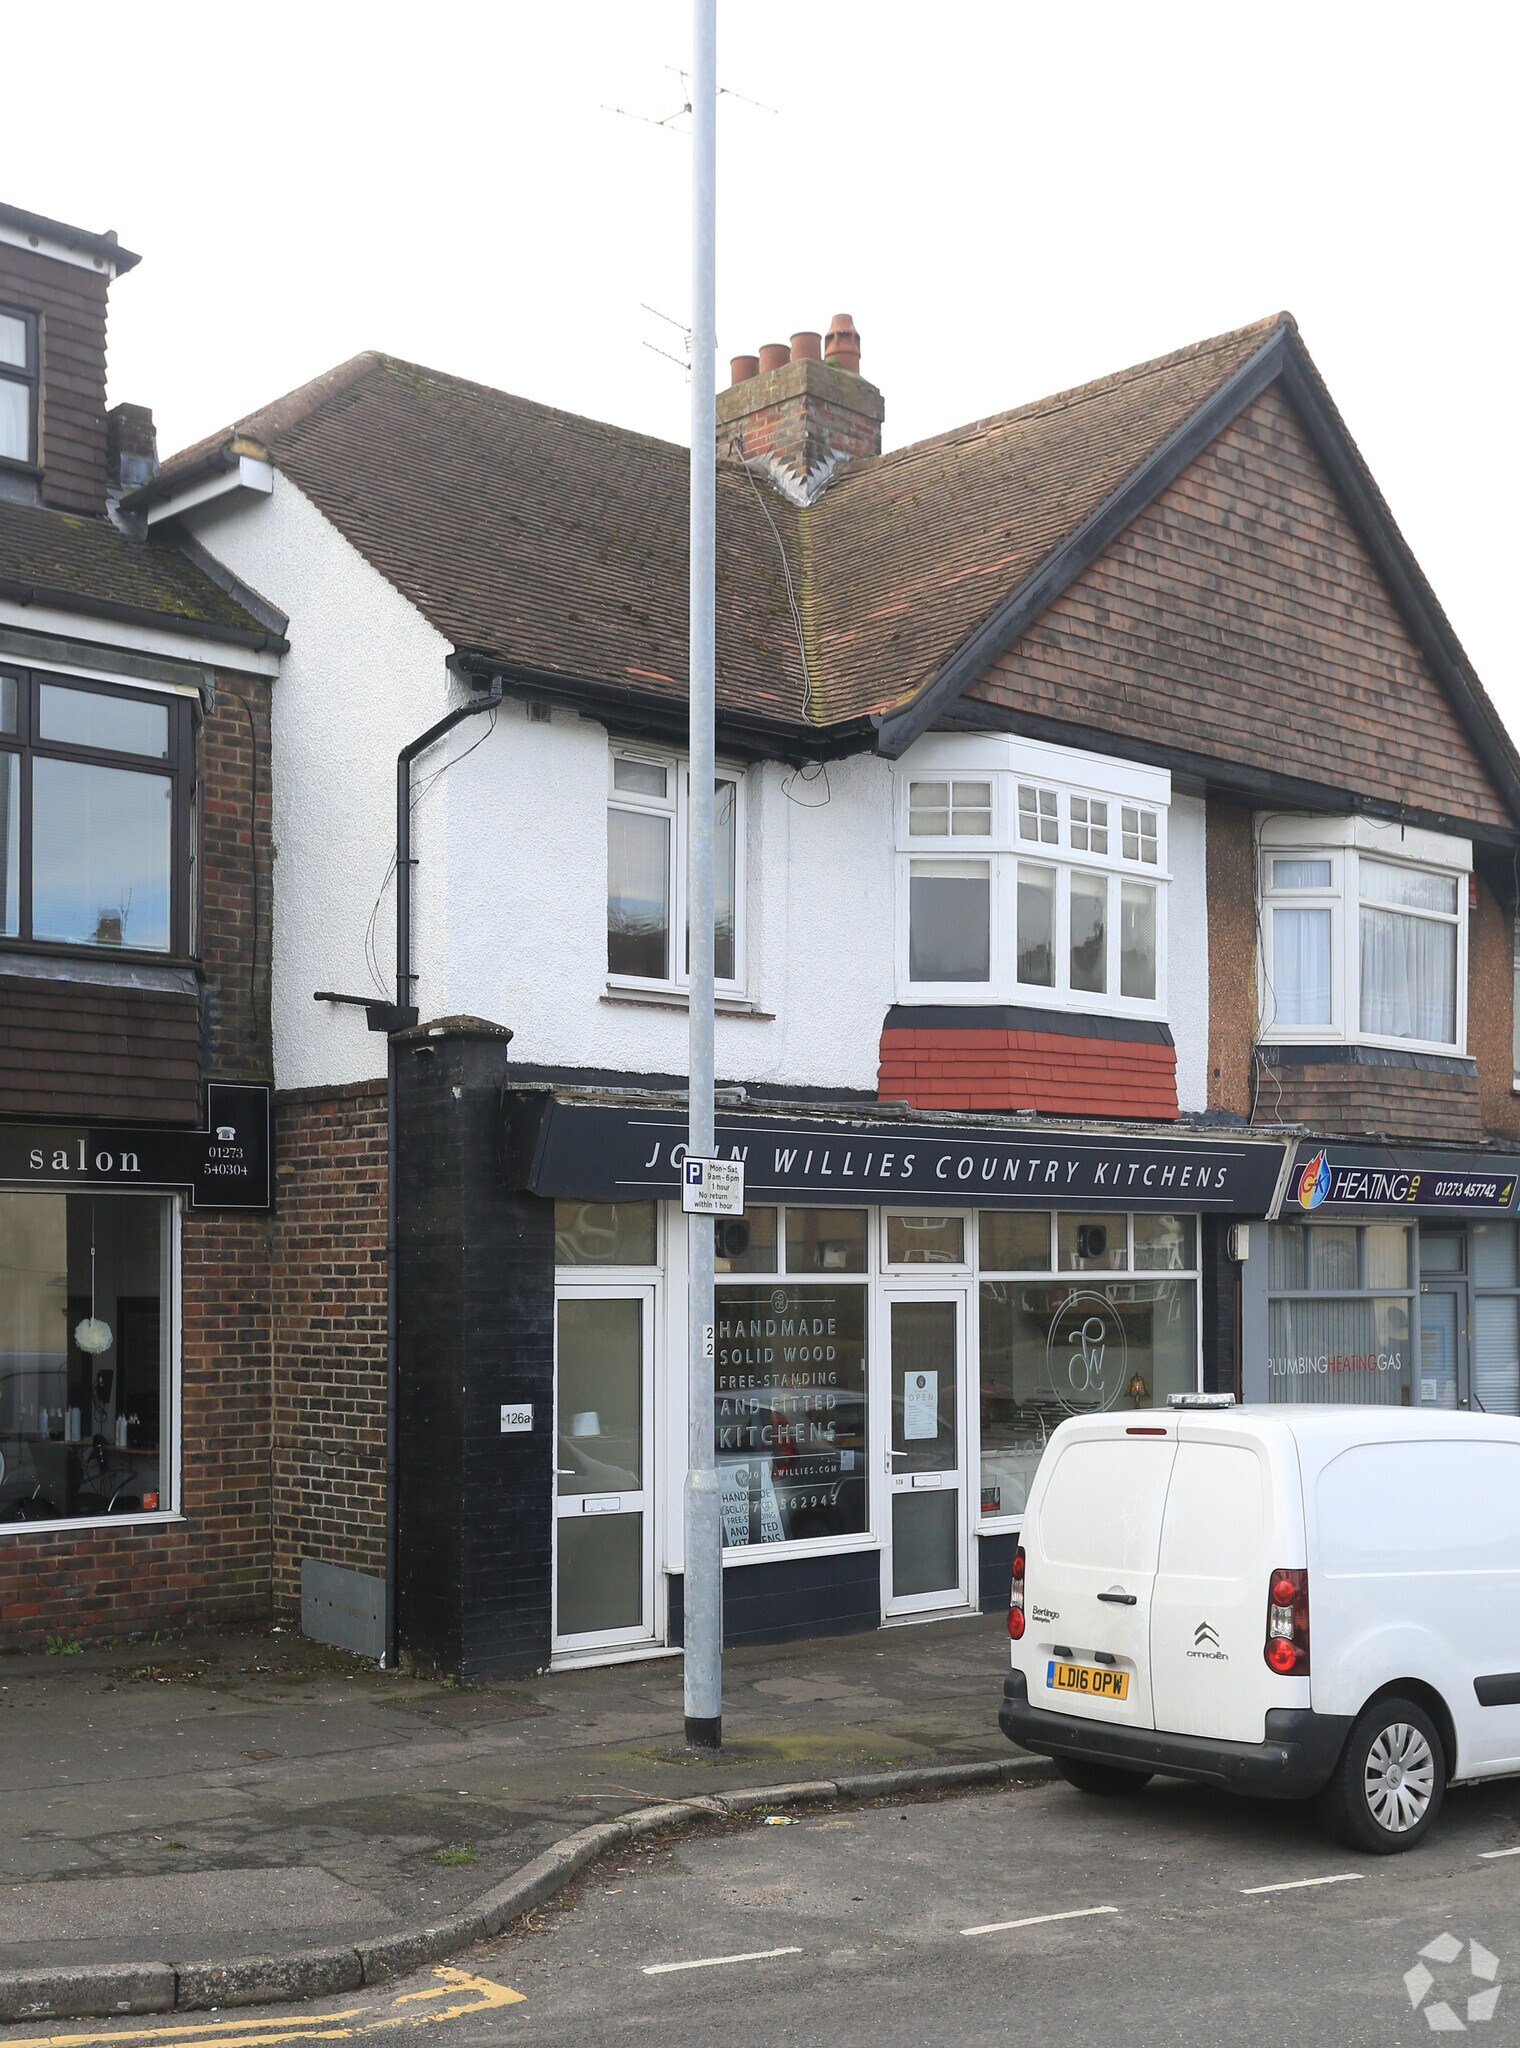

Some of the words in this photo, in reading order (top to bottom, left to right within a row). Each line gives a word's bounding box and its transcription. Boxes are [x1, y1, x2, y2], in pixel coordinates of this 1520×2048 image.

[29, 1140, 141, 1172] salon
[208, 1147, 243, 1158] 01273
[204, 1164, 248, 1175] 540304
[645, 1142, 748, 1168] JON
[774, 1148, 915, 1178] WILLIES
[935, 1155, 1079, 1183] COUNTRY
[1094, 1162, 1227, 1189] KITCHENS
[689, 1163, 700, 1183] P
[716, 1183, 730, 1191] hour
[1333, 1172, 1410, 1201] HEATING
[1407, 1175, 1421, 1201] LTD
[1435, 1182, 1463, 1196] 01273
[1463, 1182, 1497, 1198] 457742
[698, 1191, 707, 1199] No
[709, 1192, 728, 1200] return
[694, 1201, 712, 1209] within
[719, 1201, 733, 1209] hour
[706, 1327, 714, 1339] 2
[719, 1318, 837, 1339] HANDMADE
[706, 1344, 714, 1355] 2
[720, 1347, 774, 1366] SOLID
[783, 1345, 837, 1363] WOOD
[719, 1372, 837, 1389] FREE-STANDING
[720, 1397, 760, 1416] AND
[771, 1394, 837, 1413] FITTED
[908, 1393, 934, 1402] OPEN
[505, 1412, 530, 1424] 126a
[720, 1421, 837, 1448] KITCHENS
[780, 1493, 838, 1512] 562943
[1032, 1605, 1060, 1620] Berlingo
[1058, 1667, 1089, 1690] LD16
[1093, 1672, 1123, 1695] OPW
